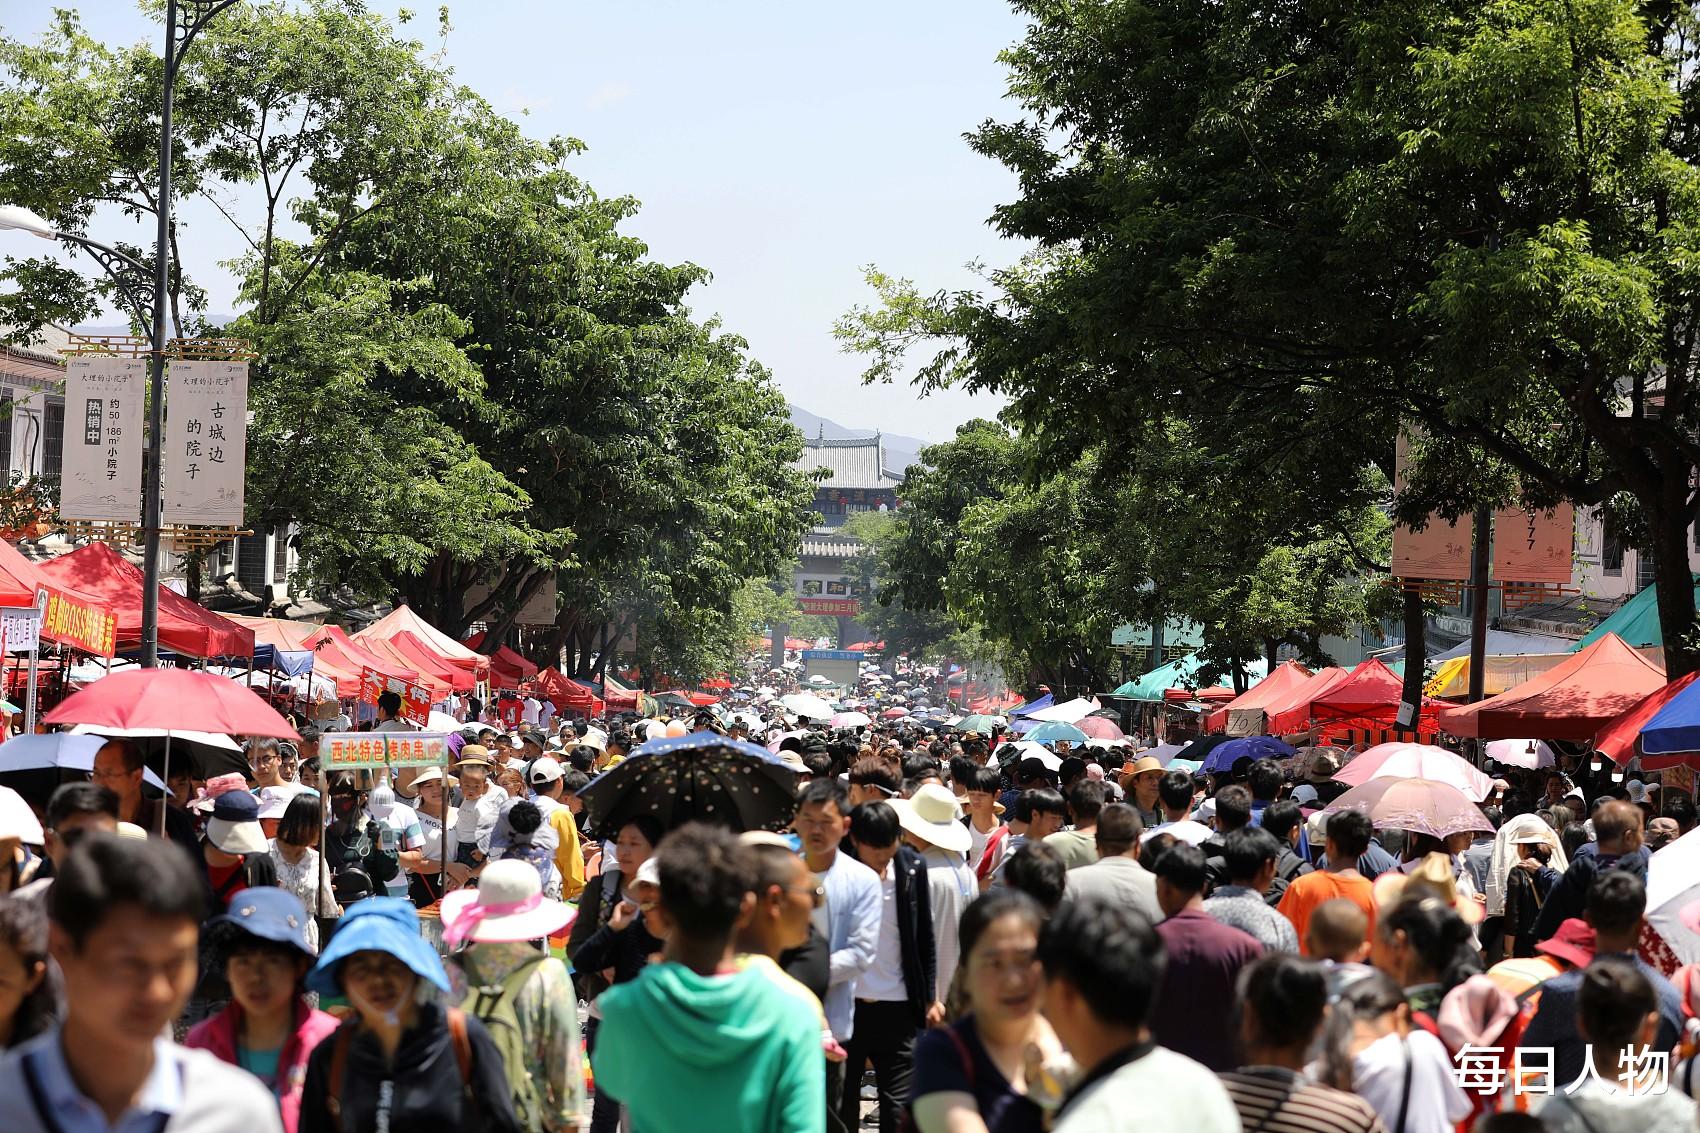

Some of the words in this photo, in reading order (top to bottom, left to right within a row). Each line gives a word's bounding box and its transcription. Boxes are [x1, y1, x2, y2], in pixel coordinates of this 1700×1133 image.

[87, 400, 102, 442] 热销中
[208, 402, 226, 464] 古城边
[185, 419, 202, 480] 的院子
[331, 738, 424, 762] 西北特色烤肉串
